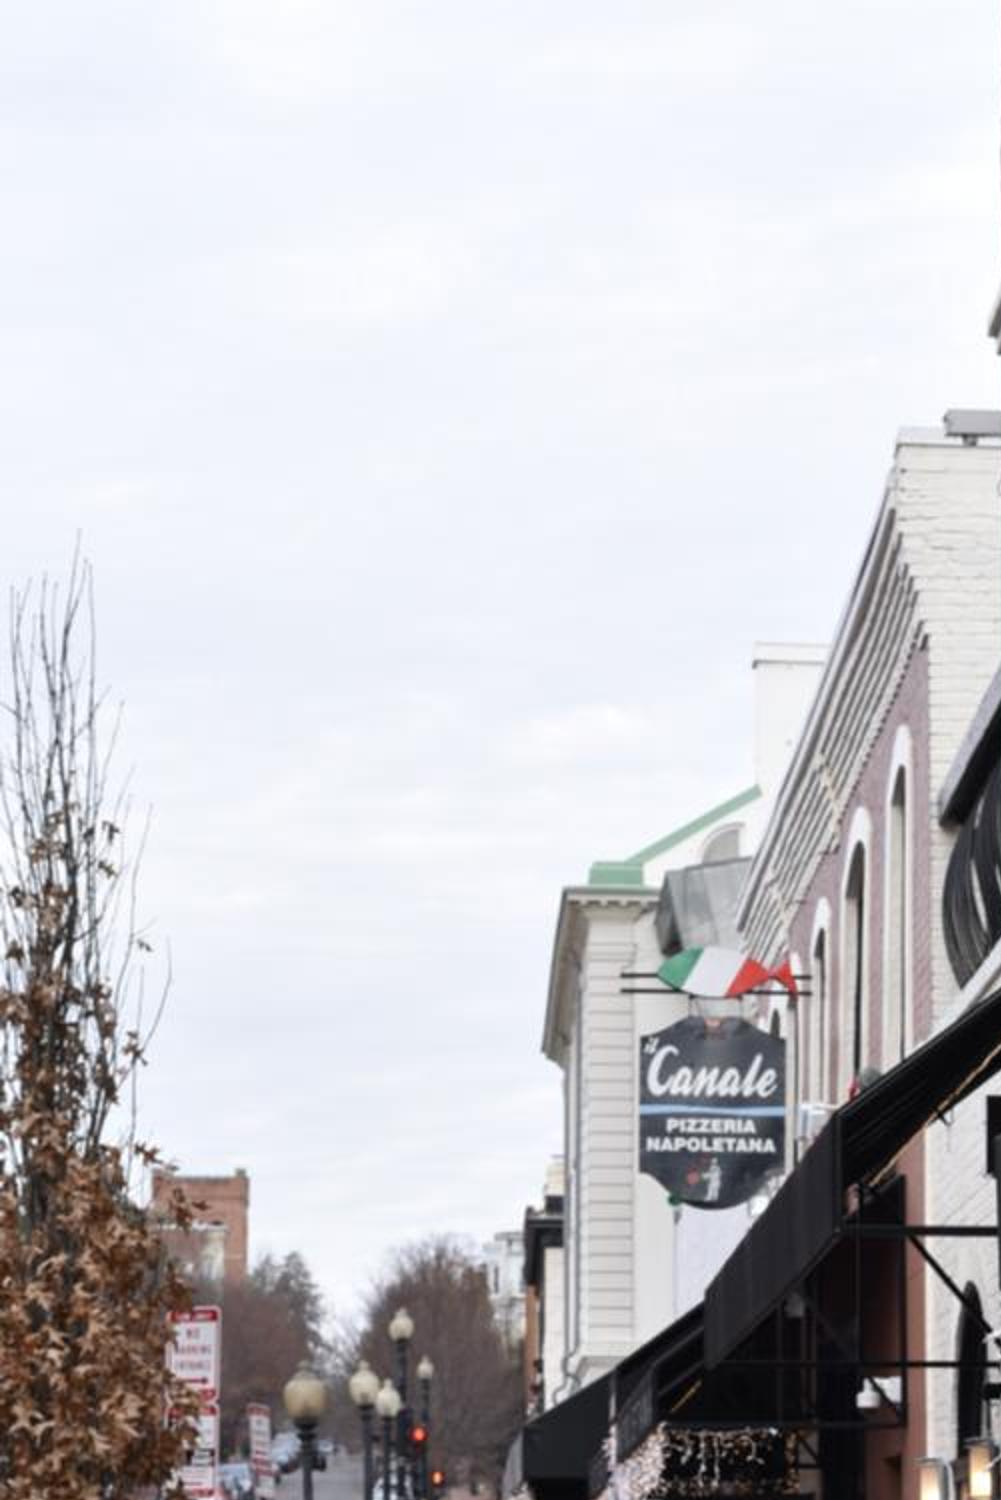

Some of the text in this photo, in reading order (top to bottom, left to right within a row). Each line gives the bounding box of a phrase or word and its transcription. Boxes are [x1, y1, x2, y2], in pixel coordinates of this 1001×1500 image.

[647, 1045, 777, 1098] Canale
[666, 1118, 757, 1134] PIZZERIA
[646, 1137, 777, 1153] NAPOLETANA
